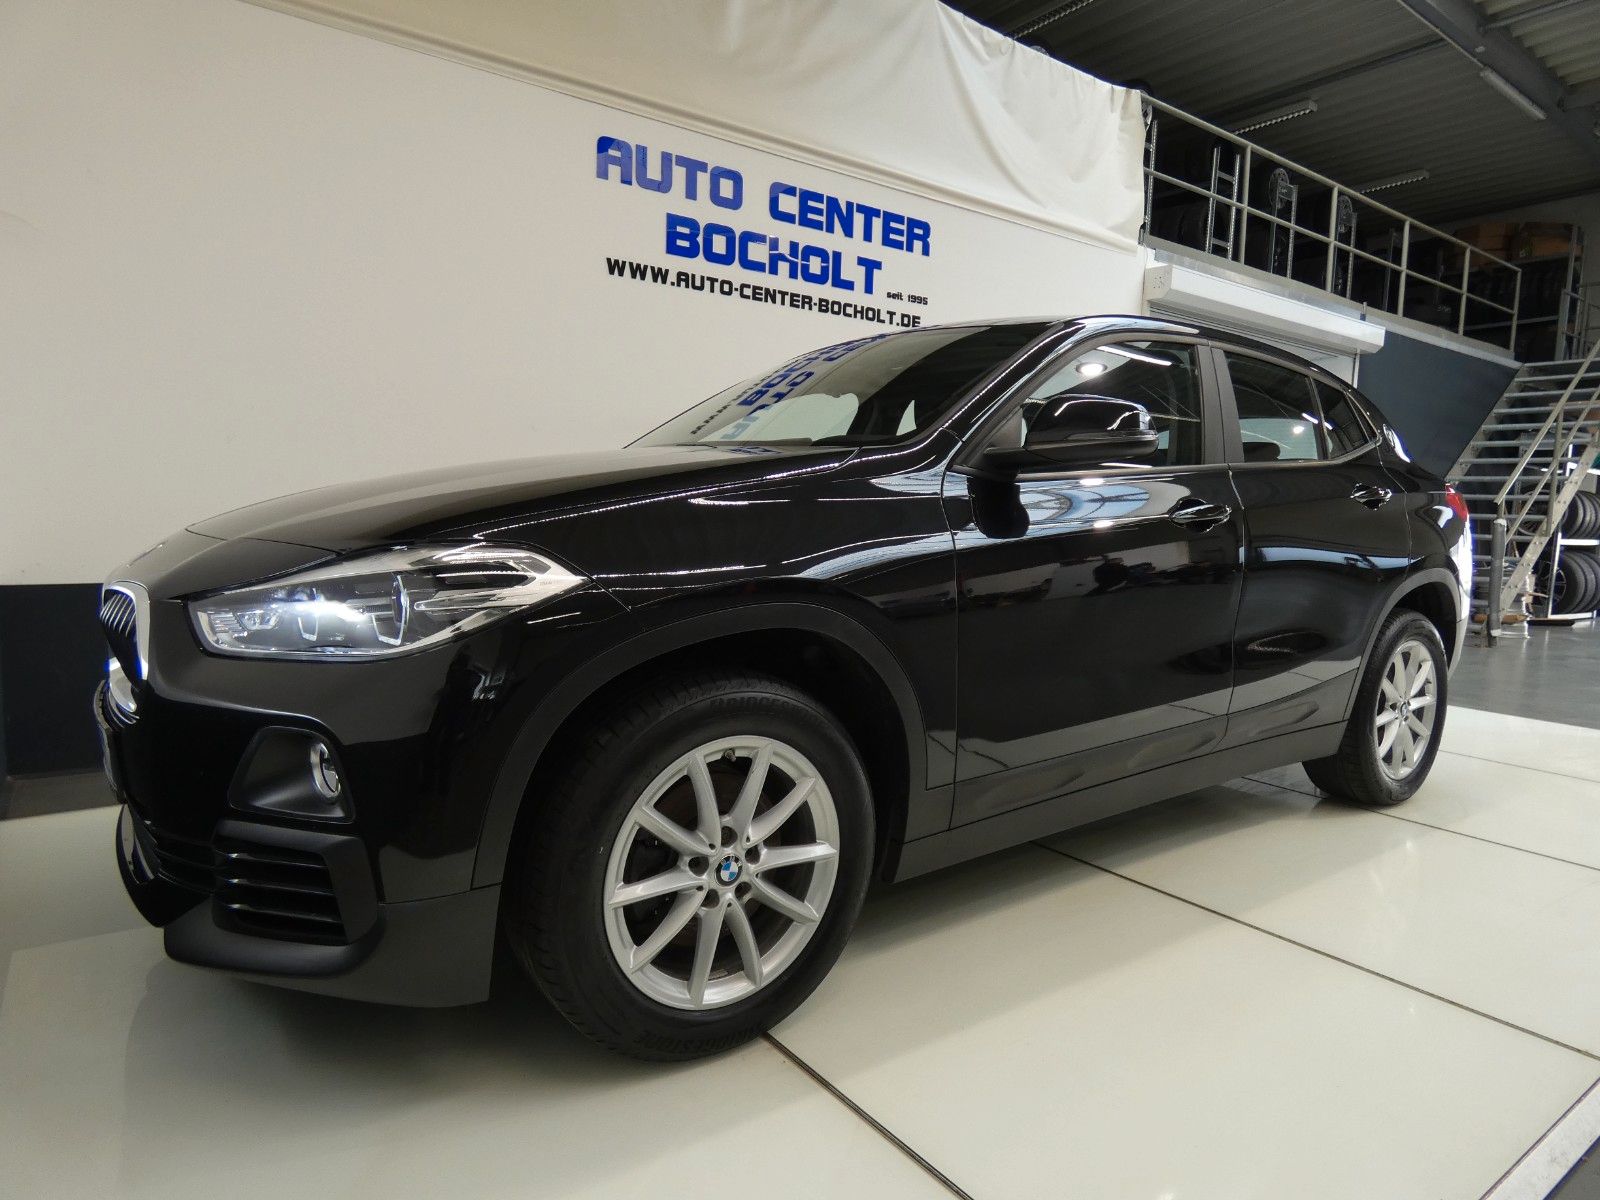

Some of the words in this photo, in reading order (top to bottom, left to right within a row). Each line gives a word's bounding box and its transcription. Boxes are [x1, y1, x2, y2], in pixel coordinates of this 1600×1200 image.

[596, 135, 744, 211] AUTO
[769, 181, 932, 257] CENTER
[666, 212, 883, 295] BOCHOLT
[886, 291, 903, 301] seit
[907, 293, 928, 306] 1995
